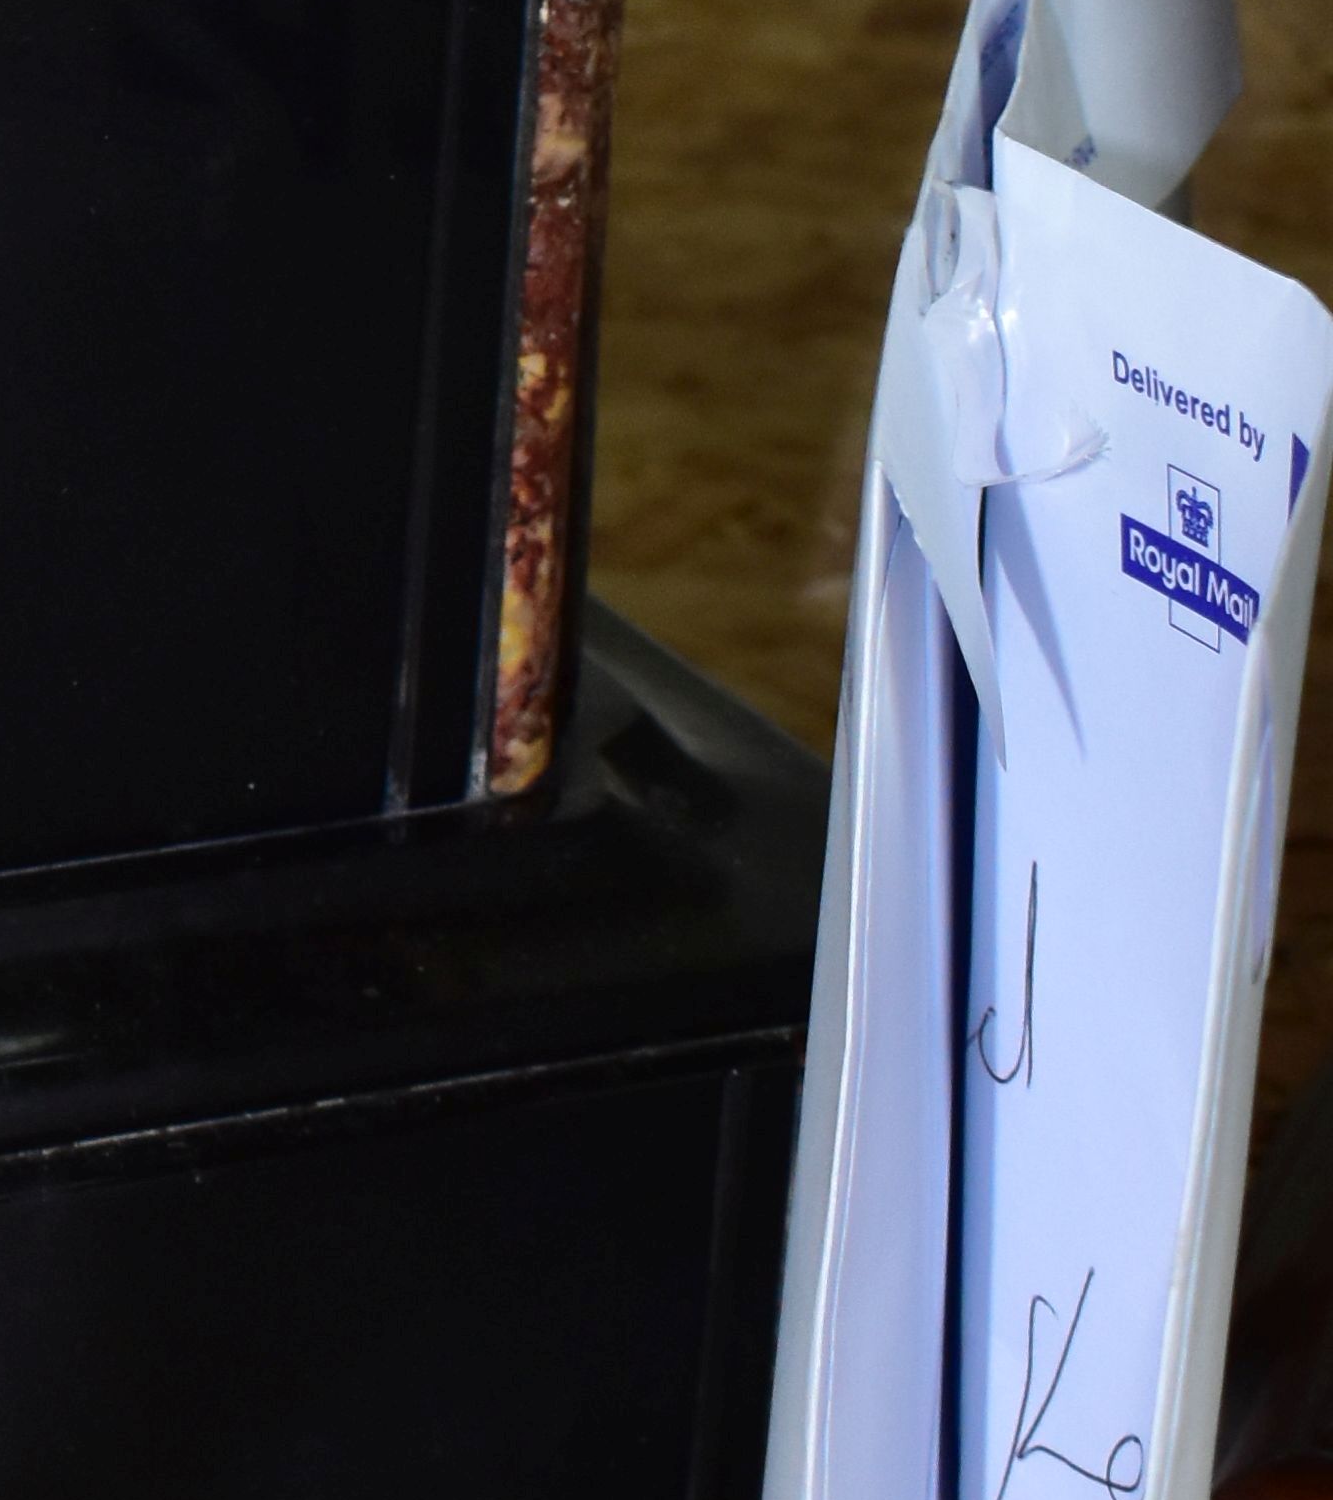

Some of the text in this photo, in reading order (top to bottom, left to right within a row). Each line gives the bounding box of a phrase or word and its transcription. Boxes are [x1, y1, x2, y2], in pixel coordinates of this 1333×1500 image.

[1111, 350, 1266, 462] Delivered by
[1129, 527, 1254, 629] Royal Mail
